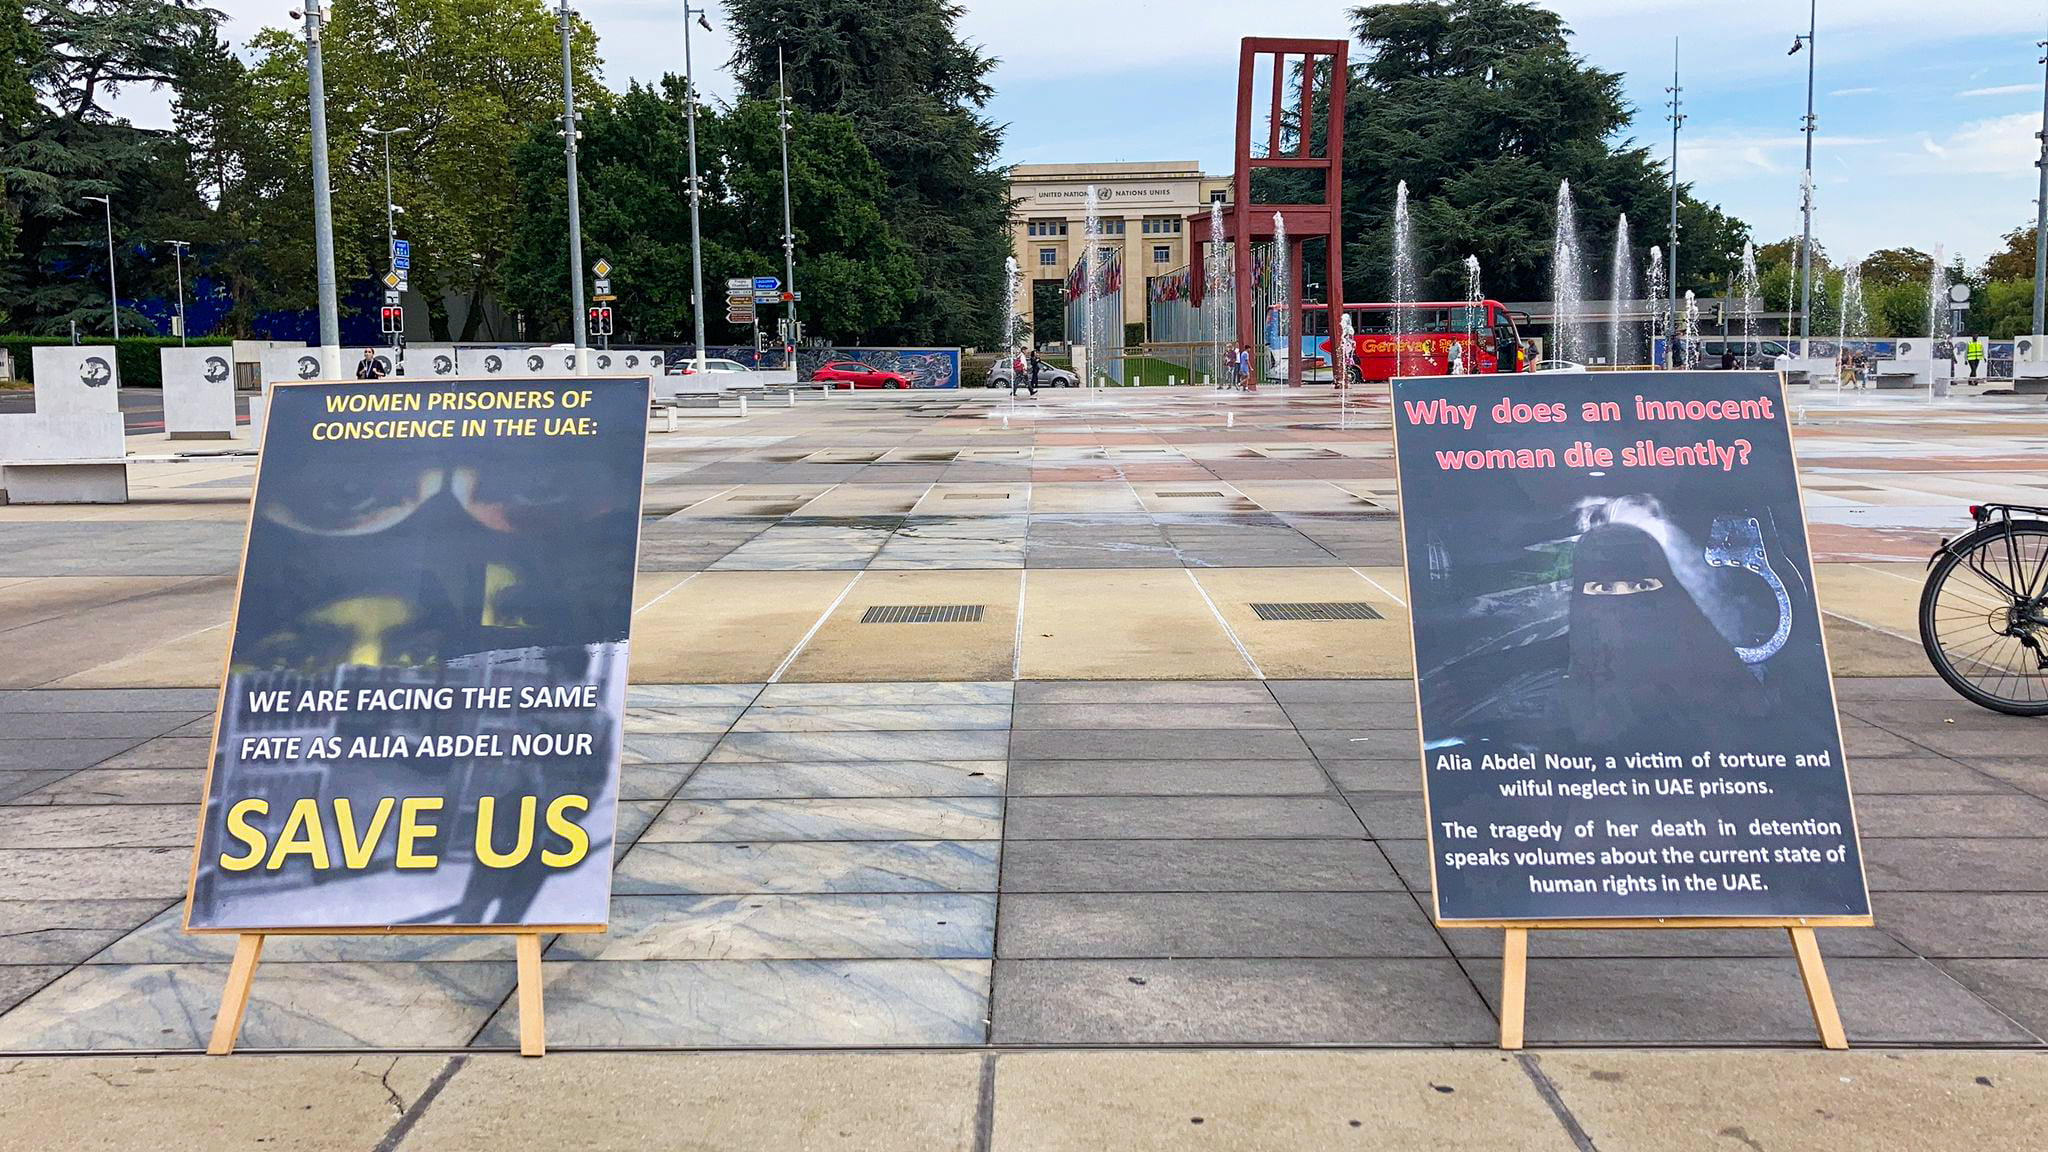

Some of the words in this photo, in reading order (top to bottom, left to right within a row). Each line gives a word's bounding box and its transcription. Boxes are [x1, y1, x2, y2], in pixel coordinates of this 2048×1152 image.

[325, 393, 421, 413] WOMEN
[427, 390, 555, 411] PRISONERS
[561, 390, 593, 409] OF
[1403, 398, 1478, 430] Why
[1491, 397, 1568, 424] does
[1581, 401, 1621, 422] an
[1634, 394, 1775, 421] innocent
[311, 419, 456, 441] CONSCIENCE
[461, 419, 487, 438] IN
[492, 418, 538, 437] THE
[543, 417, 598, 436] UAE:
[1435, 447, 1556, 471] woman
[1563, 440, 1614, 467] die
[1621, 438, 1752, 472] silently?
[249, 690, 292, 713] WE
[296, 689, 350, 712] ARE
[357, 687, 454, 711] FACING
[461, 687, 513, 709] THE
[519, 685, 598, 709] SAME
[241, 737, 302, 760] FATE
[306, 736, 342, 759] AS
[347, 736, 409, 759] ALIA
[415, 734, 504, 758] ABDEL
[511, 733, 593, 756] NOUR
[1436, 753, 1473, 771] Alia
[1480, 752, 1537, 771] Abdel
[1544, 753, 1597, 773] Nour,
[1605, 756, 1617, 769] a
[1623, 751, 1683, 769] victim
[1691, 750, 1711, 768] of
[1718, 752, 1787, 768] torture
[1795, 749, 1831, 767] and
[1498, 779, 1553, 797] wilful
[1557, 778, 1628, 800] neglect
[1631, 778, 1651, 796] in
[1654, 778, 1695, 796] UAE
[1699, 777, 1774, 799] prisons.
[218, 796, 444, 872] SAVE
[474, 794, 591, 870] US
[1440, 821, 1478, 839] The
[1488, 820, 1563, 842] tragedy
[1574, 819, 1595, 838] of
[1605, 819, 1639, 838] her
[1650, 818, 1707, 838] death
[1717, 818, 1737, 836] in
[1748, 817, 1842, 836] detention
[1444, 847, 1510, 868] speaks
[1513, 847, 1596, 866] volumes
[1600, 846, 1658, 865] about
[1660, 845, 1695, 864] the
[1699, 847, 1770, 864] current
[1773, 846, 1822, 863] state
[1825, 844, 1846, 863] of
[1528, 874, 1598, 893] human
[1602, 873, 1658, 897] rights
[1660, 873, 1681, 892] in
[1683, 873, 1718, 892] the
[1721, 873, 1769, 891] UAE.
